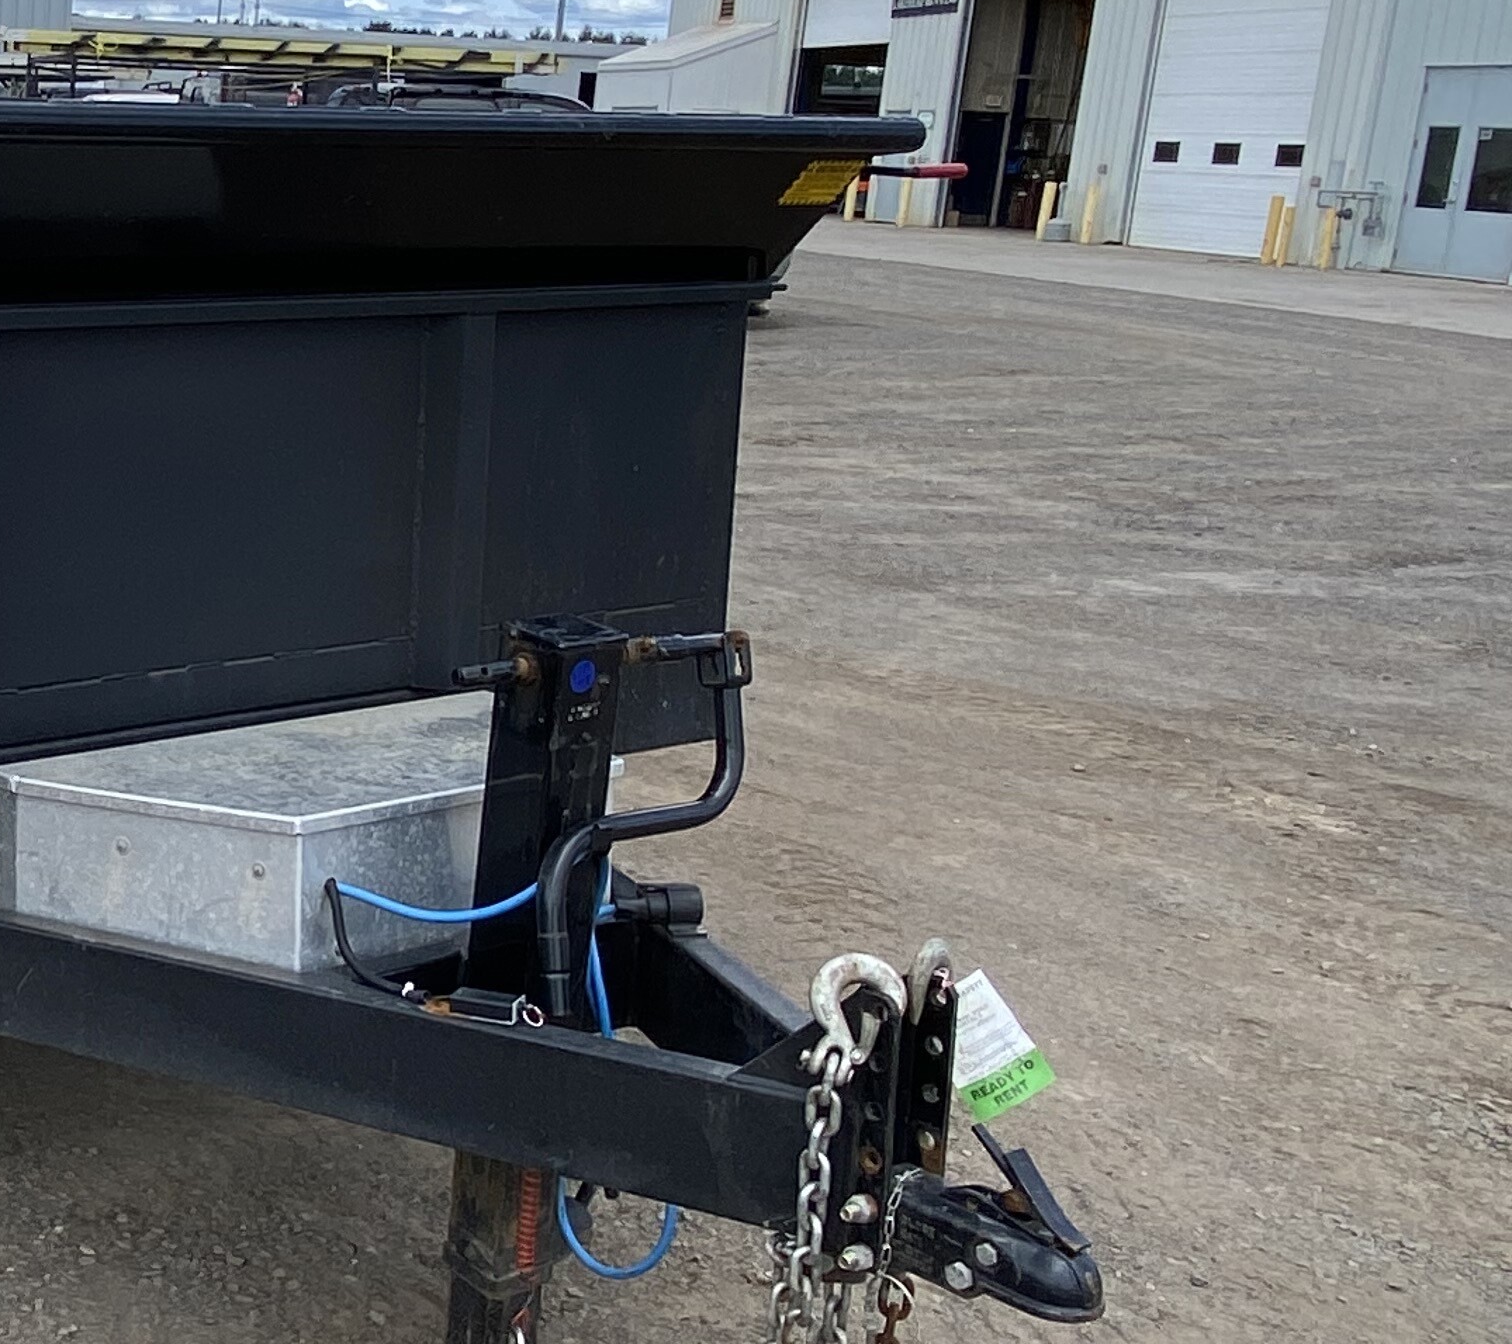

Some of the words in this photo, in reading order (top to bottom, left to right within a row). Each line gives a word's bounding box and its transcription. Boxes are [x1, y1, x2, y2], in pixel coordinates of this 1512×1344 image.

[970, 1070, 1015, 1102] READY
[1016, 1059, 1034, 1075] TO
[993, 1079, 1030, 1106] RENT
